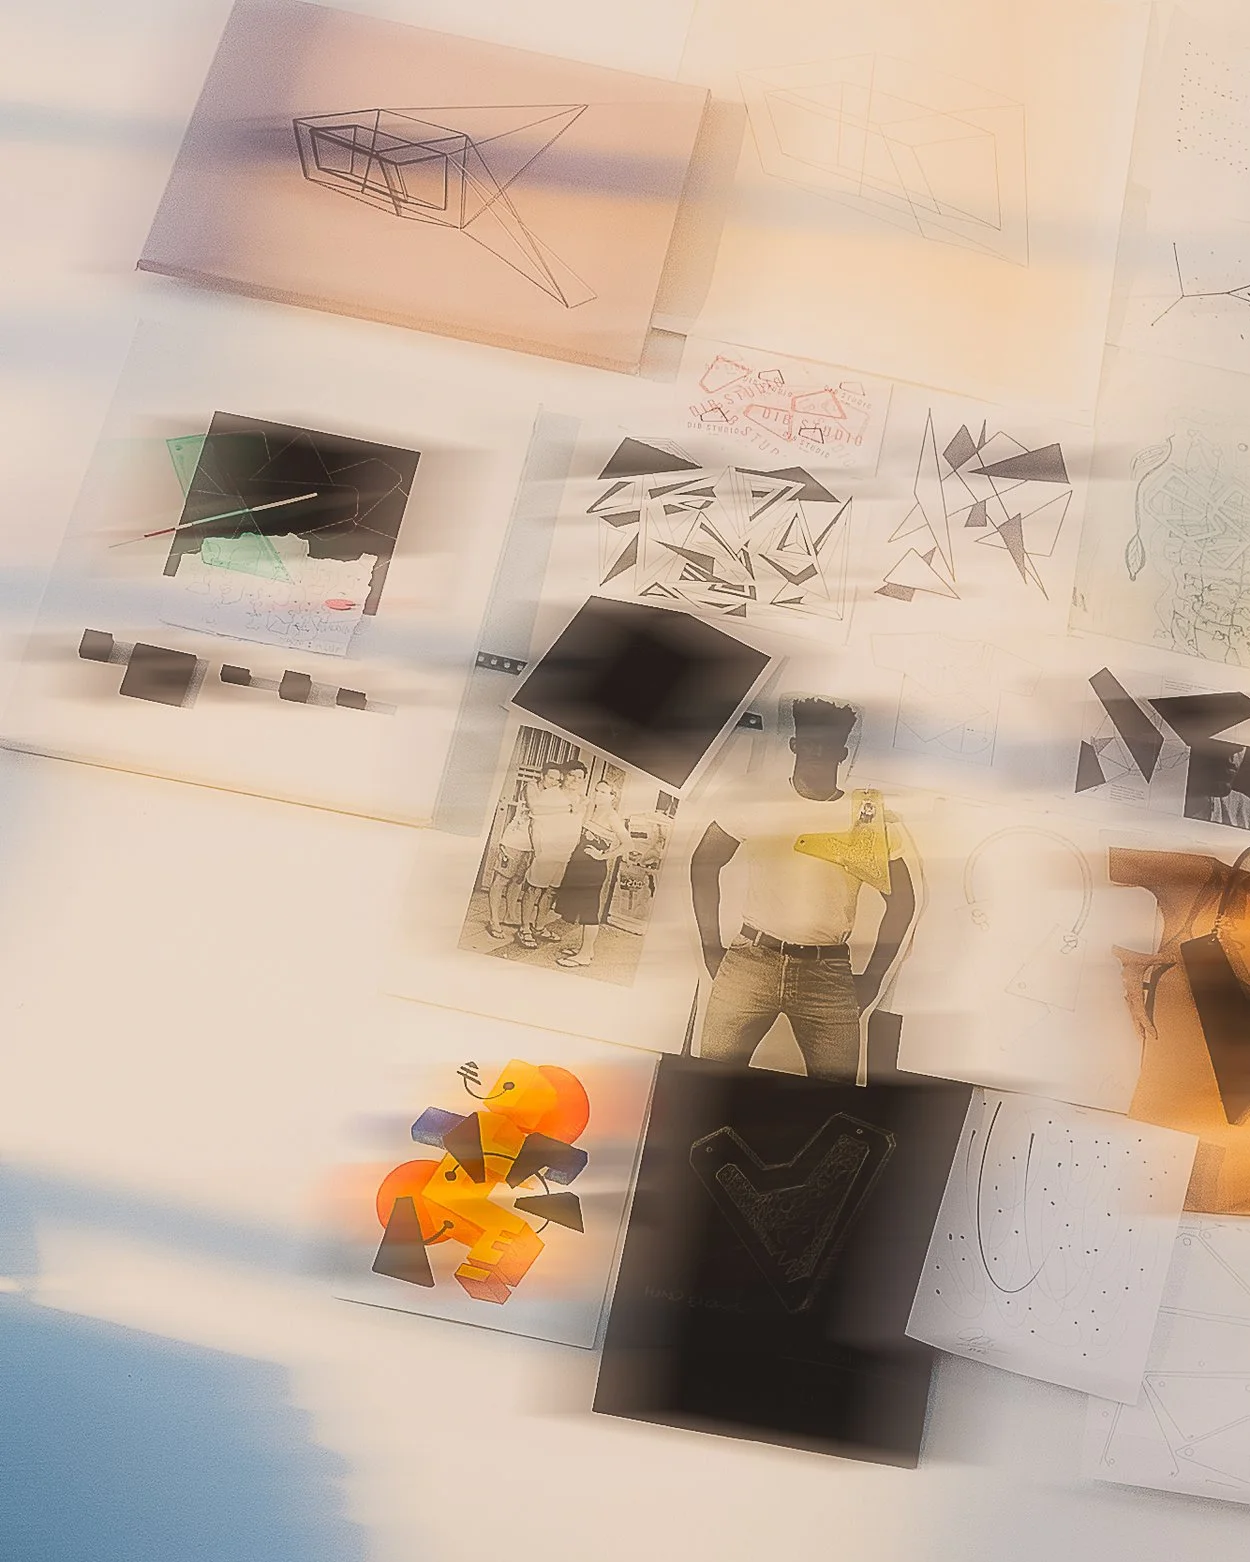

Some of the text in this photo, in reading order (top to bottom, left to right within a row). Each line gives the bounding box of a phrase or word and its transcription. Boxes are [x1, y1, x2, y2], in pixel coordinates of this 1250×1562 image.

[687, 421, 740, 435] DIB STUDIO
[762, 407, 863, 447] DIB STUDIO
[800, 441, 831, 458] STUDIO
